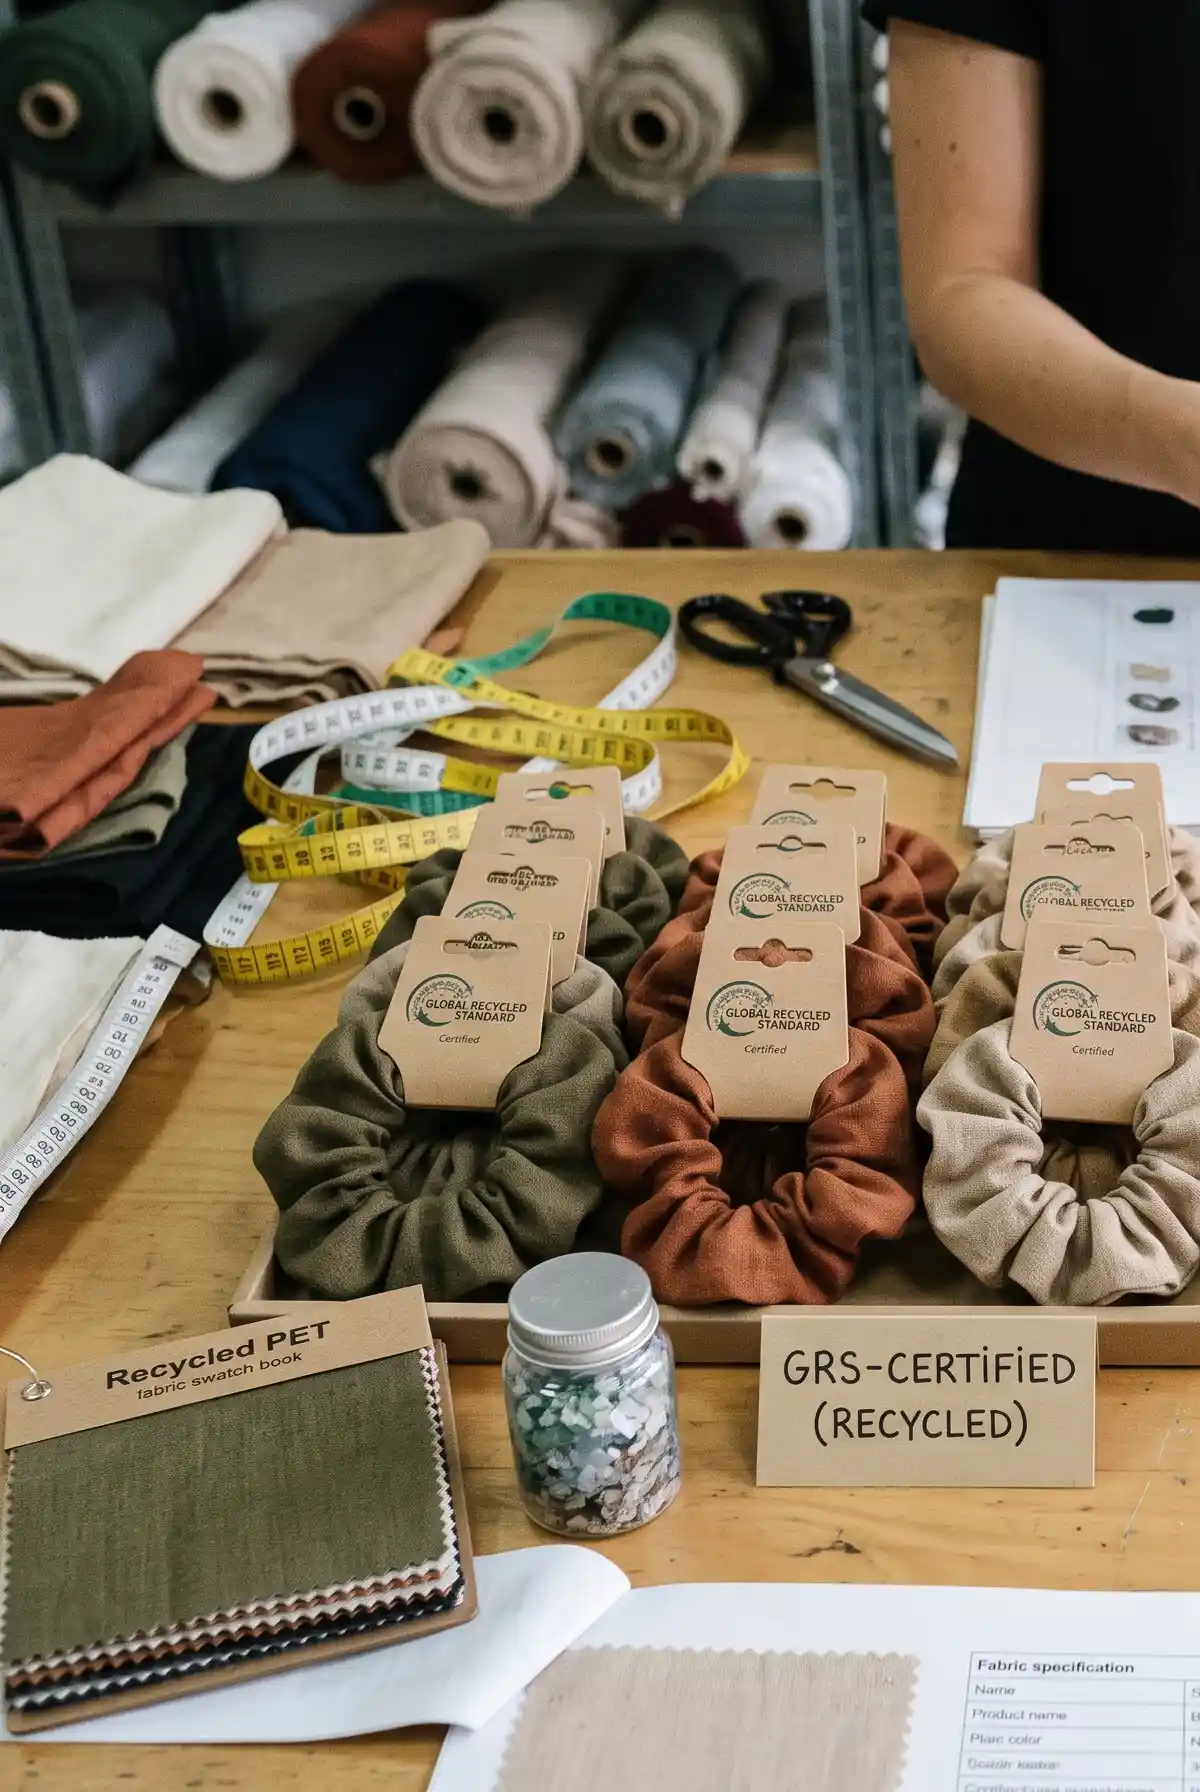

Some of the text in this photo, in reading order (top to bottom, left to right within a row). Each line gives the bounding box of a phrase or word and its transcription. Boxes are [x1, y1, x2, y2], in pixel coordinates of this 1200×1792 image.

[746, 893, 844, 904] GLOBAL RECYCLED
[1080, 898, 1135, 908] RECYCLED
[776, 903, 835, 912] STANDARD
[425, 999, 527, 1013] GLOBAL RECYCLED
[454, 1010, 516, 1023] STANDARD
[726, 1008, 831, 1021] GLOBAL RECYCLED
[1051, 1007, 1156, 1024] GLOBAL RECYCLED
[757, 1019, 820, 1031] STANDARD
[1083, 1020, 1146, 1034] STANDARD
[438, 1034, 480, 1044] Certified
[744, 1043, 787, 1054] Certified
[1072, 1045, 1115, 1056] Certified
[106, 1320, 331, 1390] Recycled PET
[136, 1351, 303, 1400] fabric swatch book
[814, 1399, 1028, 1447] (RECYCLED)
[977, 1659, 1135, 1676] Fabric specification
[974, 1684, 1016, 1696] Name
[972, 1708, 1068, 1721] Product name
